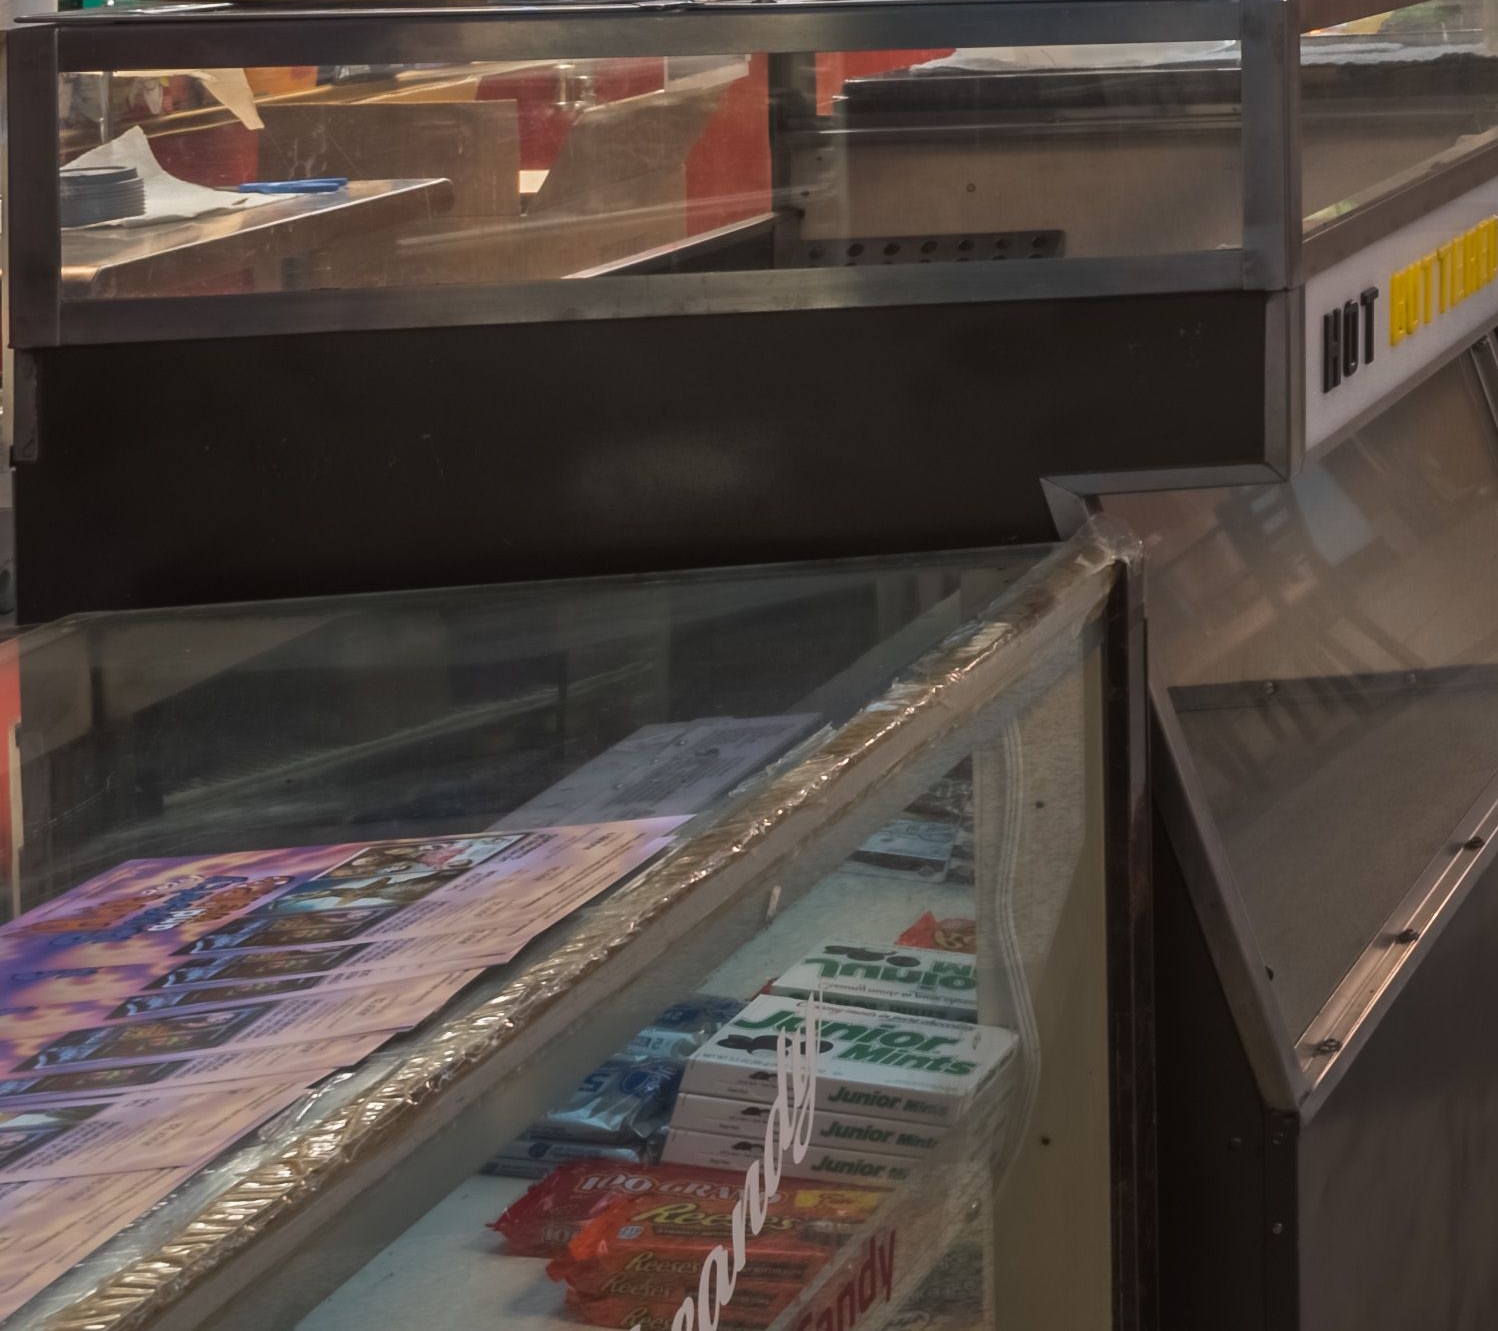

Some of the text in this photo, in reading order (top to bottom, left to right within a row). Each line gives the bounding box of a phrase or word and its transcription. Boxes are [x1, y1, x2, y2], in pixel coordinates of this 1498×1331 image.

[1322, 286, 1379, 394] HOT
[1389, 215, 1498, 347] BUTTERED
[733, 1010, 960, 1052] Junior
[837, 1043, 978, 1075] Mints
[827, 1085, 902, 1111] Junior
[819, 1119, 898, 1145] Junior
[810, 1154, 884, 1180] Junior
[580, 1170, 655, 1196] 100
